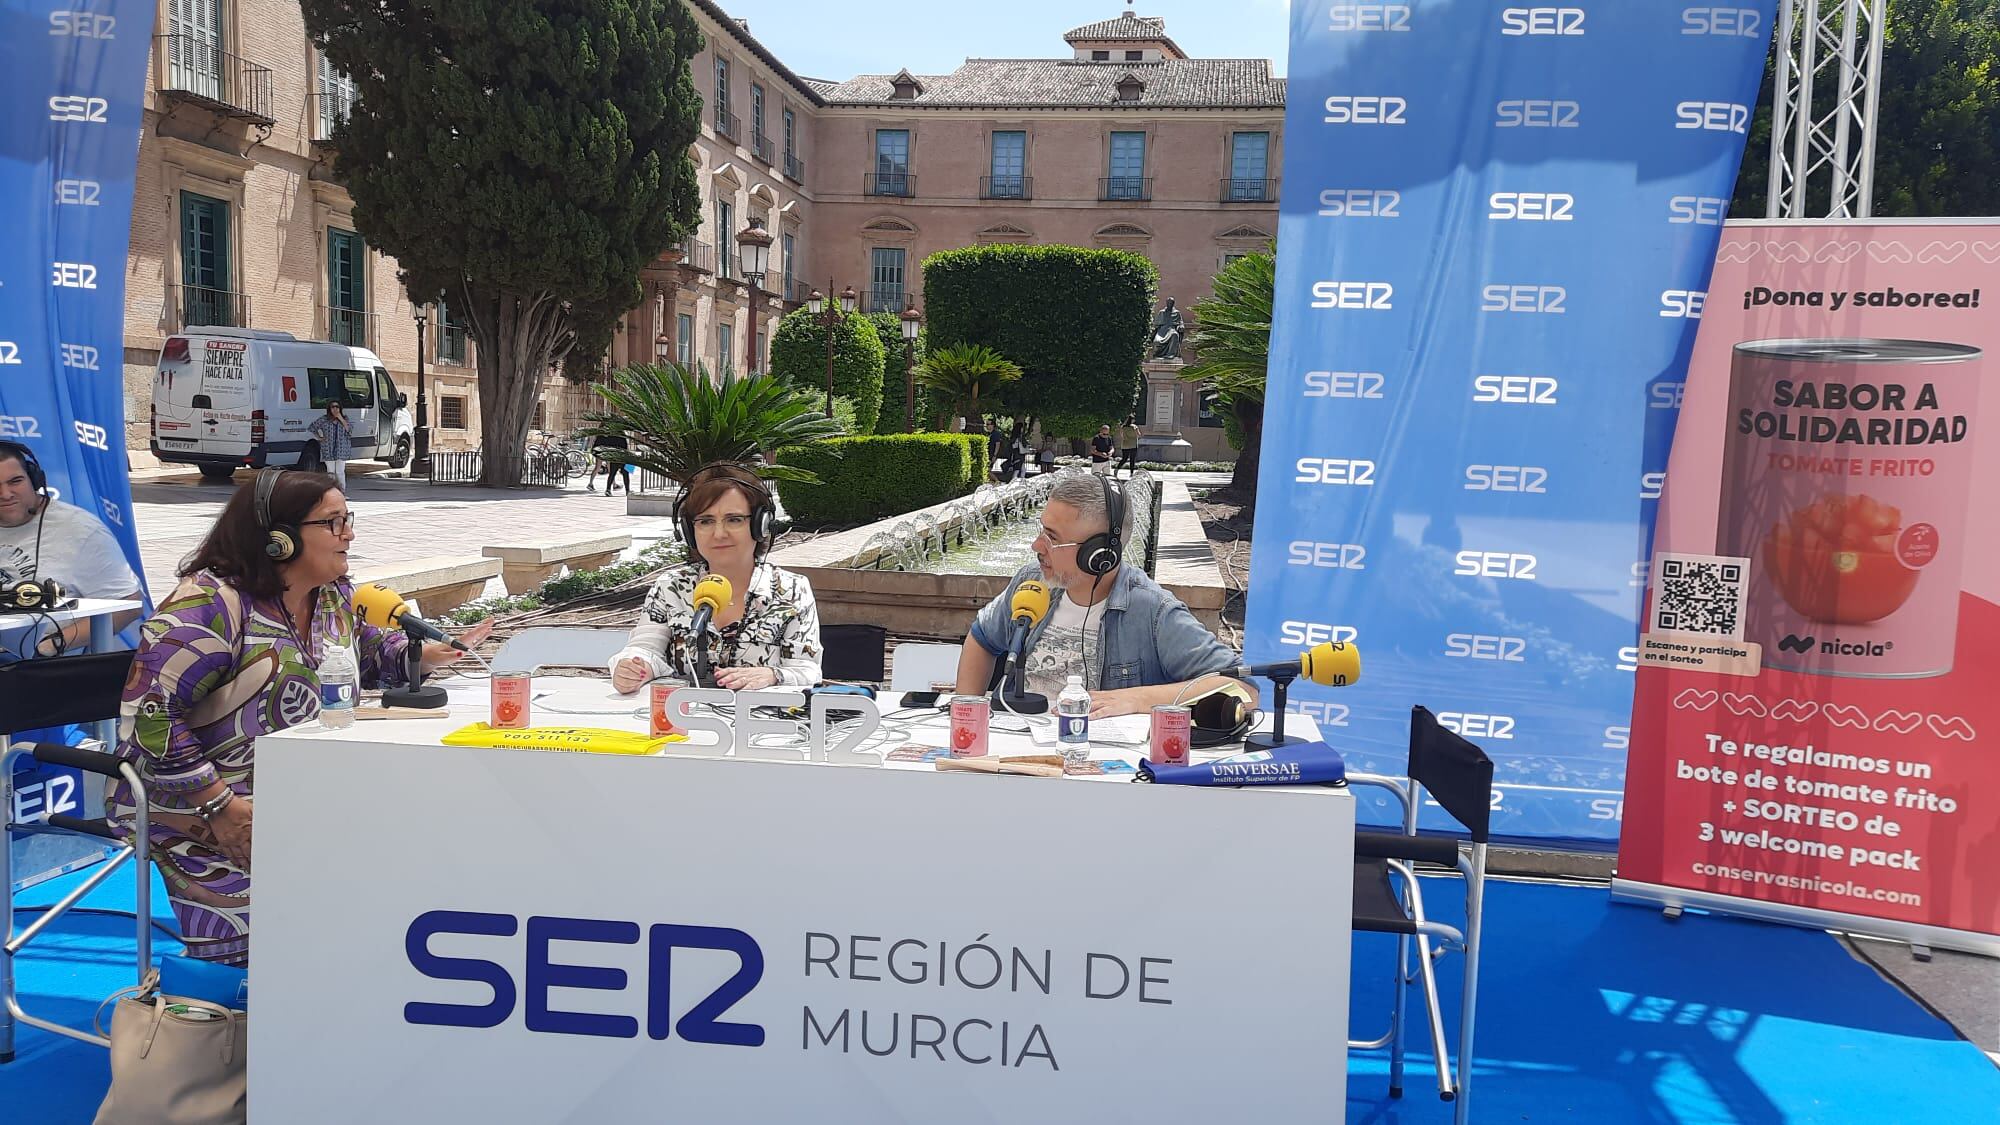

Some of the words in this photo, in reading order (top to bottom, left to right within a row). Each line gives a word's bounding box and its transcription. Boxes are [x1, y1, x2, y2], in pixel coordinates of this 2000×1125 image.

[49, 11, 116, 39] SER
[1329, 4, 1410, 32] SER
[1502, 7, 1585, 36] SER
[1681, 7, 1760, 38] SER
[50, 95, 108, 122] SER
[1324, 96, 1406, 125] SER
[1495, 100, 1580, 128] SER
[1675, 101, 1748, 134] SER
[1319, 189, 1400, 217] SER
[1488, 192, 1574, 221] SER
[1311, 281, 1392, 310] SER
[1481, 285, 1566, 313] SER
[1660, 290, 1708, 318] SE
[1744, 287, 1824, 310] ¡Dona
[1829, 291, 1848, 311] y
[1852, 288, 1981, 308] saborea!
[206, 349, 245, 367] SIEMPRE
[205, 365, 221, 379] HACE
[222, 366, 243, 381] FALTA
[1304, 371, 1384, 399] SER
[1473, 375, 1557, 404] SER
[1650, 382, 1686, 409] SE
[1773, 380, 1906, 411] SABOR
[1914, 383, 1939, 411] A
[74, 420, 108, 450] SER
[1738, 407, 1967, 445] SOLIDARIDAD
[1296, 457, 1375, 485] SER
[1464, 465, 1548, 494] SER
[1767, 453, 1863, 477] TOMATE
[1869, 458, 1935, 477] FRITO
[1288, 541, 1366, 570] SER
[1454, 550, 1537, 580] SER
[1445, 633, 1525, 663] SER
[1645, 652, 1657, 660] en
[1659, 653, 1668, 661] el
[1670, 655, 1704, 665] sorteo
[1646, 640, 1689, 652] Escanea
[1691, 644, 1697, 654] y
[1698, 646, 1747, 658] participa
[664, 687, 882, 766] SER
[1436, 711, 1515, 739] SER
[1211, 763, 1300, 776] UNIVERSAE
[1705, 733, 1738, 756] Te
[1743, 740, 1890, 774] regalamos
[1895, 761, 1931, 779] un
[1246, 775, 1277, 783] Superior
[1676, 759, 1739, 786] bote
[1744, 770, 1779, 791] de
[1784, 773, 1888, 806] tomate
[1895, 787, 1958, 814] frito
[1722, 800, 1738, 813] +
[1743, 799, 1859, 831] SORTEO
[1864, 817, 1901, 838] de
[1698, 822, 1714, 842] 3
[1720, 827, 1845, 860] welcome
[1850, 848, 1921, 871] pack
[1691, 861, 1922, 907] conservasnicola.com
[403, 909, 766, 1047] SER
[804, 932, 1053, 995] REGIÓN
[1084, 952, 1174, 1005] DE
[802, 1005, 1060, 1071] MURCIA
